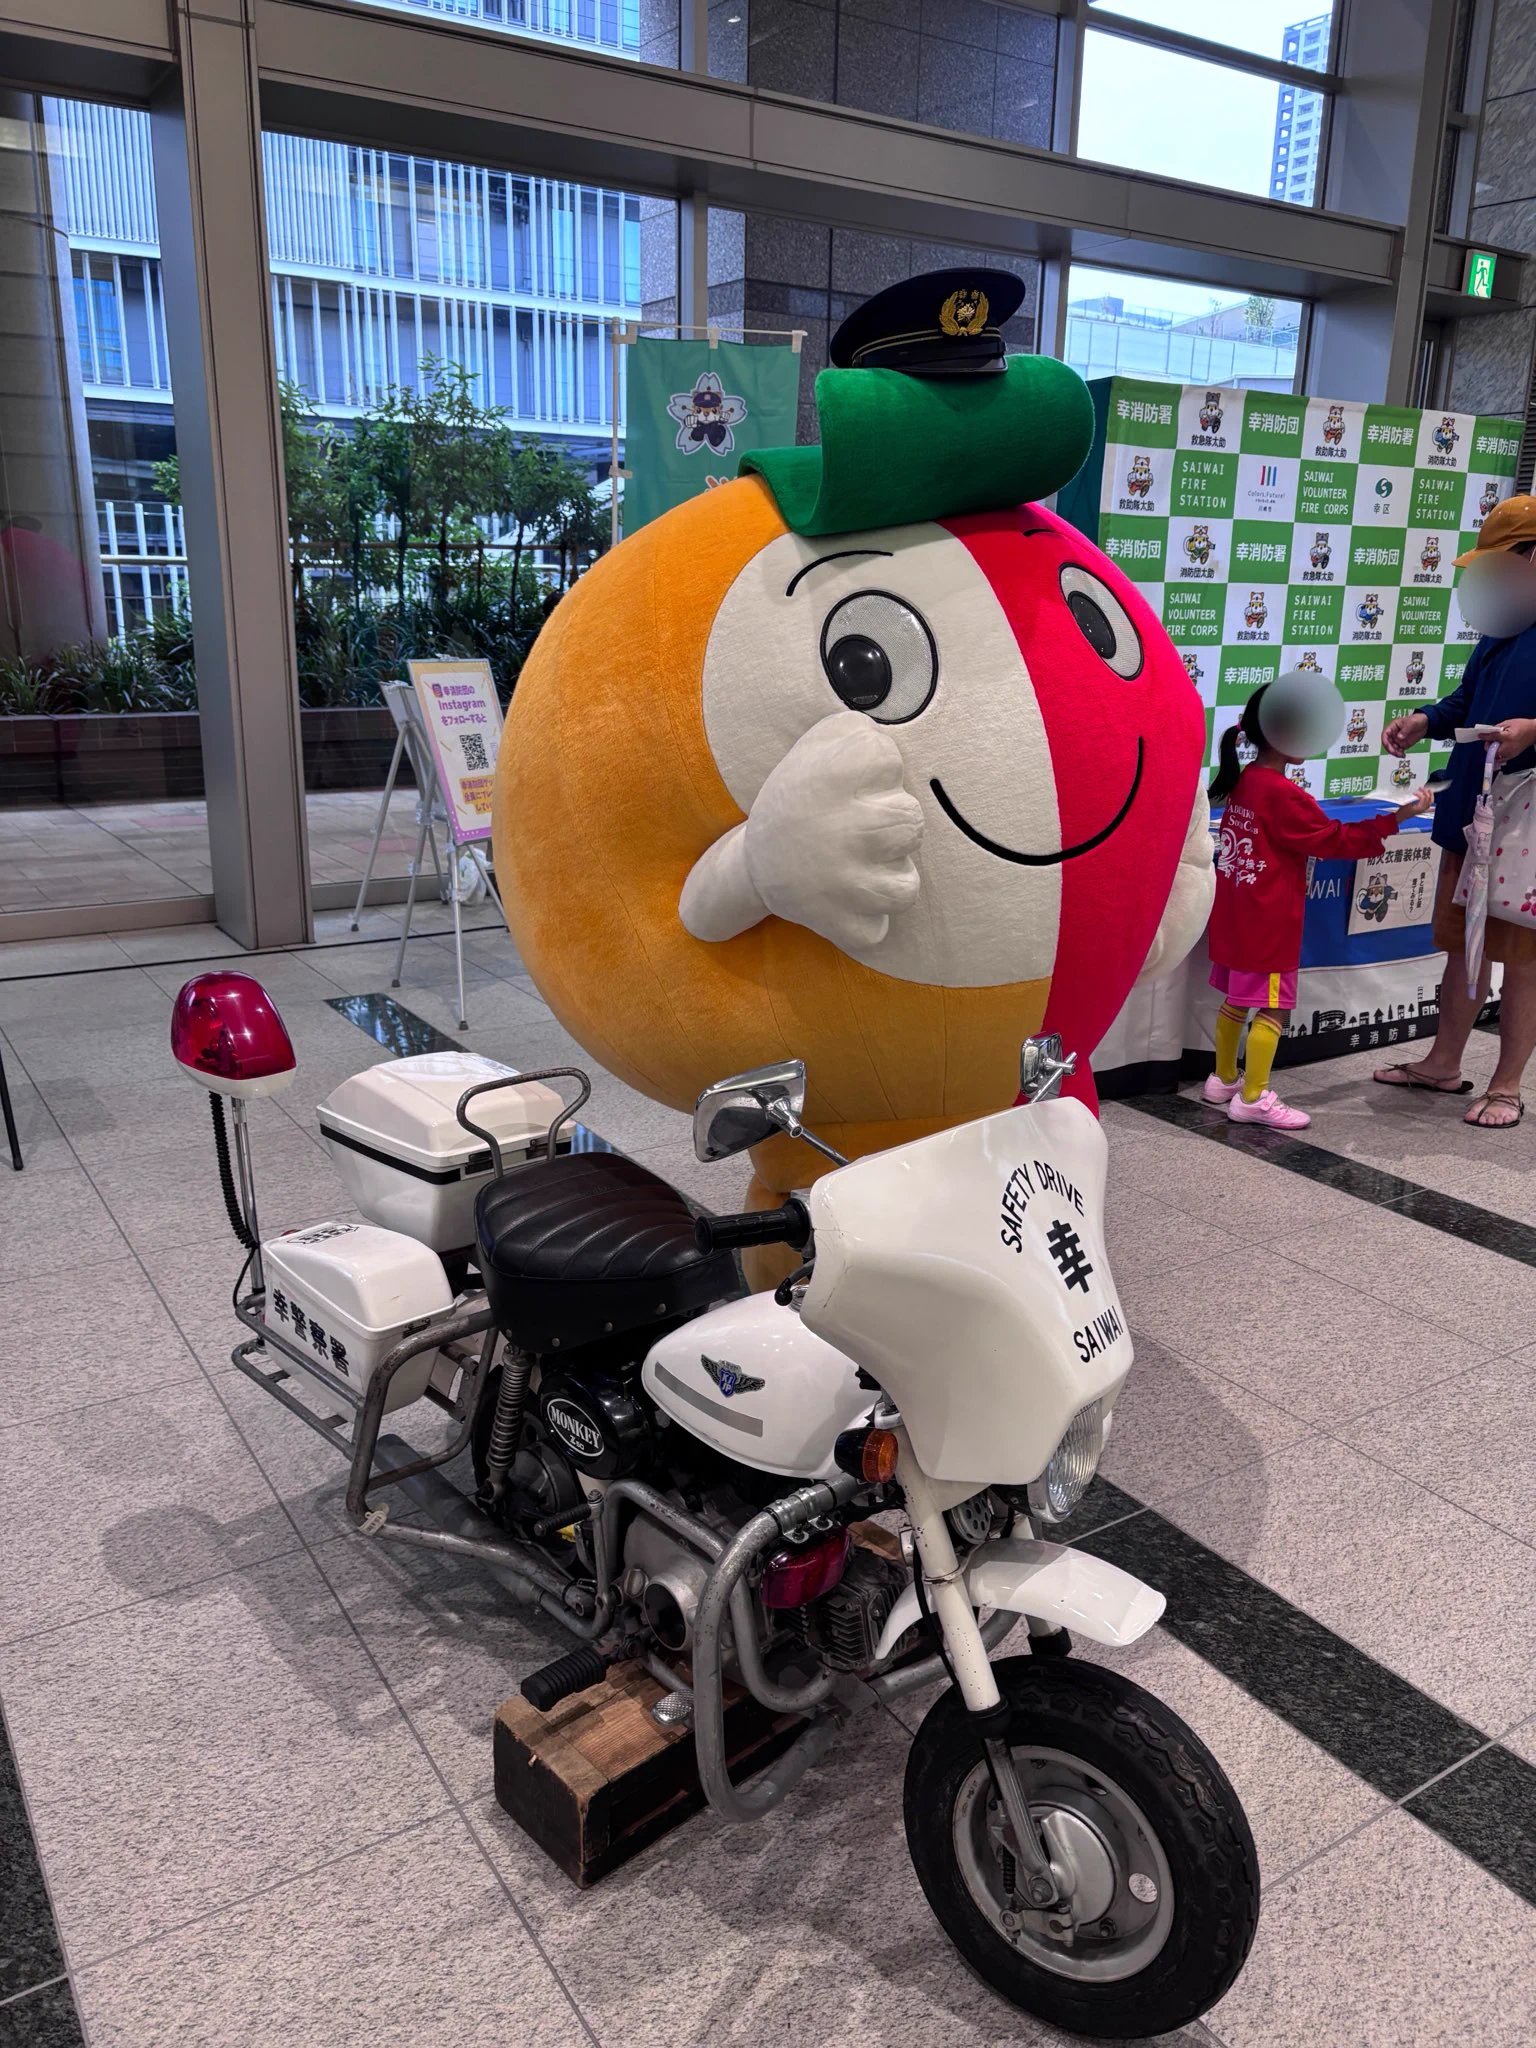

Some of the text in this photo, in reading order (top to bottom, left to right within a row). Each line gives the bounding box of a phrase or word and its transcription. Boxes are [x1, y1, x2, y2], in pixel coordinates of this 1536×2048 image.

[1117, 399, 1172, 425] 幸消防署
[1249, 412, 1299, 435] 幸消防団
[1191, 434, 1226, 448] 救急隊太助
[1367, 424, 1414, 446] 幸消防署
[1315, 445, 1347, 458] 救助隊太助
[1476, 436, 1520, 457] 幸消防団
[1427, 455, 1457, 467] 消防隊太助
[1183, 461, 1224, 476] SAIWAI
[1304, 470, 1334, 483] SAIWAI
[1181, 478, 1207, 491] FIRE
[1419, 478, 1454, 492] SAIWAI
[1303, 486, 1347, 499] VOLUNTEER
[1417, 493, 1439, 505] FIRE
[1119, 498, 1154, 512] 救助隊太助
[1179, 495, 1227, 509] STATION
[1301, 502, 1349, 515] FIRE CORPS
[1373, 502, 1391, 515] 幸区
[1416, 508, 1455, 521] STATION
[1105, 537, 1162, 559] 幸消防団
[1236, 542, 1287, 563] 幸消防署
[1354, 547, 1400, 566] 幸消防団
[1180, 567, 1214, 579] 消防団太助
[1302, 571, 1334, 582] 救急隊太助
[1169, 592, 1201, 604] SAIWAI
[1294, 595, 1332, 606] SAIWAI
[1403, 596, 1430, 607] SAIWAI
[1168, 608, 1216, 621] VOLUNTEER
[1293, 610, 1316, 621] FIRE
[1401, 610, 1441, 621] VOLUNTEER
[1166, 624, 1218, 636] FIRE CORPS
[1237, 630, 1270, 641] 救助隊太助
[1291, 624, 1333, 636] STATION
[1399, 624, 1442, 635] FIRE CORPS
[1224, 666, 1275, 685] 幸消防団
[1340, 665, 1386, 682] 幸消防署
[438, 699, 486, 712] Instagram
[1328, 776, 1374, 795] 幸消防団
[1350, 1024, 1417, 1048] 幸消防署
[1000, 1160, 1085, 1254] SAFETY DRIVE
[1046, 1219, 1094, 1294] 幸
[273, 1288, 350, 1378] 幸警察署
[1073, 1305, 1124, 1364] SAIWAI
[550, 1405, 600, 1449] MONKEY
